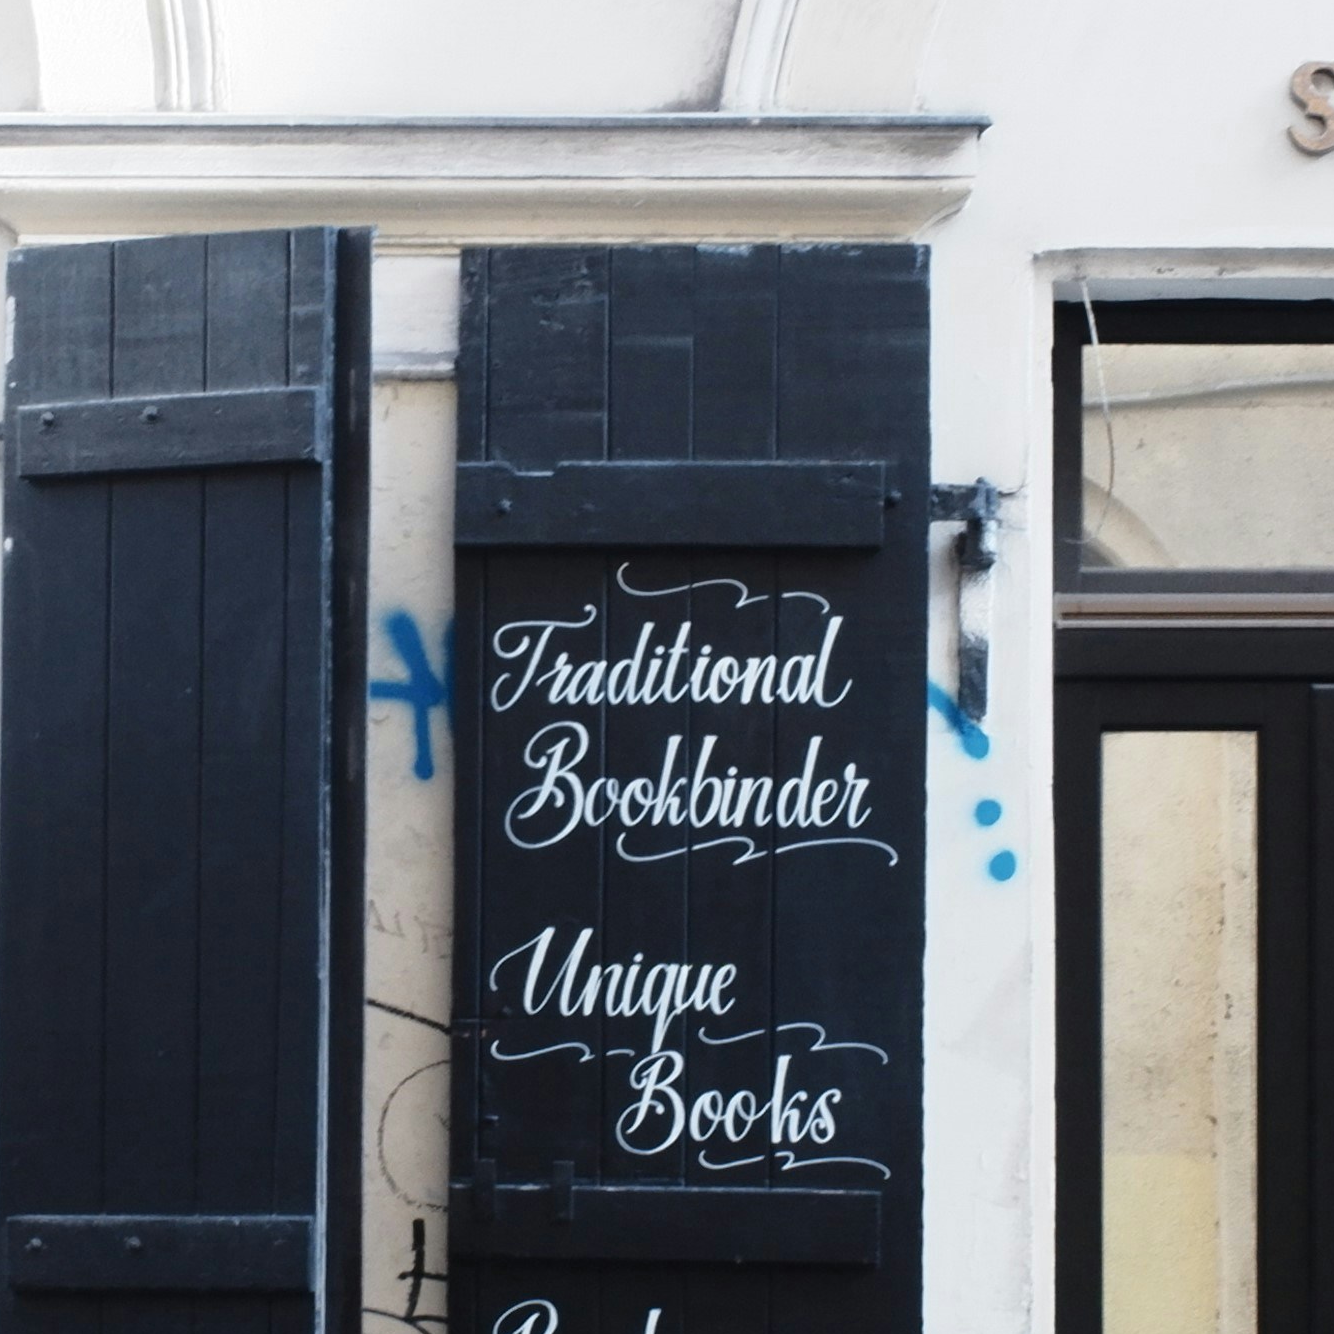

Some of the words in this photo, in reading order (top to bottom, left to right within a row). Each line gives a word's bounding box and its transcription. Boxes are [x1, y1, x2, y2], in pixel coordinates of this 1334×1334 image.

[490, 603, 854, 713] Traditional
[504, 720, 873, 849] Bookbinder
[490, 926, 738, 1053] Unique
[615, 1049, 843, 1155] Books
